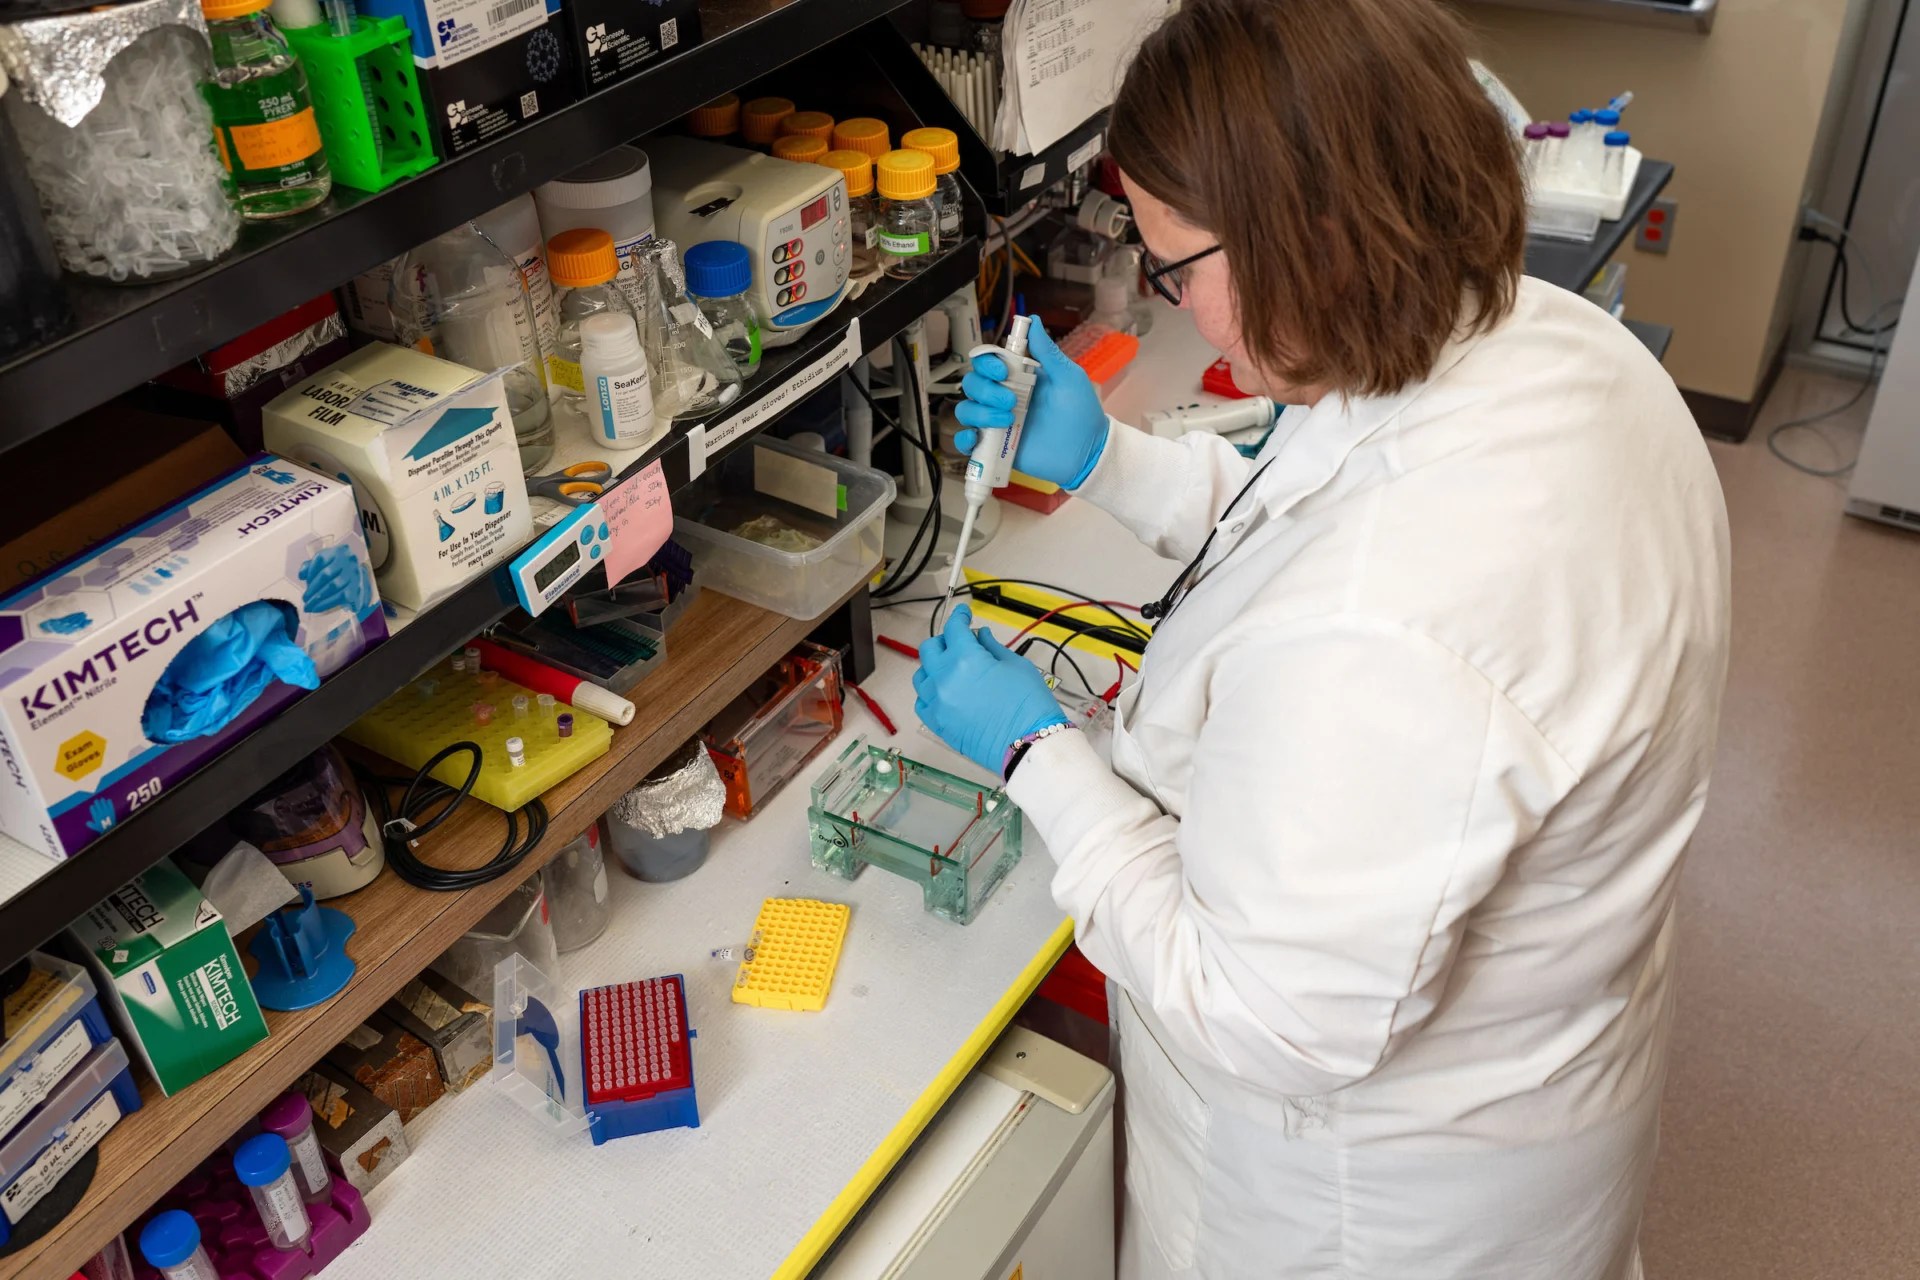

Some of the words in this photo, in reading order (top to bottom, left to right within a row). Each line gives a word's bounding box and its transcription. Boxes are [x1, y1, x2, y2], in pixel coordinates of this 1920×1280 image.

[600, 28, 625, 43] Genesee
[607, 34, 630, 48] Scientific
[258, 96, 280, 110] 250
[892, 240, 916, 249] Ethanol
[391, 382, 440, 398] PARAFILM
[600, 378, 610, 411] Lonza
[704, 422, 738, 450] Warning!
[741, 410, 758, 425] Wear
[762, 388, 788, 412] Gloves!
[792, 366, 824, 392] Ethidium
[826, 348, 849, 370] Bromide
[308, 406, 348, 426] FILM
[408, 462, 431, 478] Dispense
[432, 450, 454, 465] Parafilm
[454, 438, 474, 454] Through
[474, 433, 485, 442] This
[486, 422, 502, 437] Opening
[1001, 424, 1013, 458] eppendor
[427, 467, 438, 476] When
[438, 460, 452, 472] Empty
[481, 439, 490, 449] Your
[442, 460, 462, 476] Laboratory
[462, 452, 478, 466] Supplier
[434, 490, 440, 502] 4
[442, 484, 454, 499] IN.
[456, 478, 462, 490] X
[464, 468, 480, 485] 125
[481, 460, 494, 476] FT.
[438, 548, 448, 560] For
[450, 542, 462, 552] Use
[462, 536, 469, 546] In
[470, 528, 484, 540] Your
[485, 510, 512, 532] Dispenser
[450, 550, 464, 562] Simply
[464, 544, 474, 554] Press
[474, 536, 488, 548] Thumbs
[488, 526, 504, 540] Through
[451, 552, 474, 568] Perforations
[480, 538, 494, 552] Corners
[494, 532, 506, 544] Below
[468, 556, 482, 568] PINCH
[482, 548, 494, 560] HERE
[85, 676, 118, 700] Nitrile
[64, 740, 94, 761] Exam
[66, 750, 100, 774] Gloves
[126, 776, 163, 812] 250
[100, 816, 112, 830] M
[201, 913, 217, 924] 1
[220, 953, 233, 979] Kimwipes
[204, 958, 242, 1026] KIMTECH
[211, 1000, 222, 1019] SCIENCE
[40, 1164, 49, 1177] 10
[62, 1126, 88, 1154] Reach
